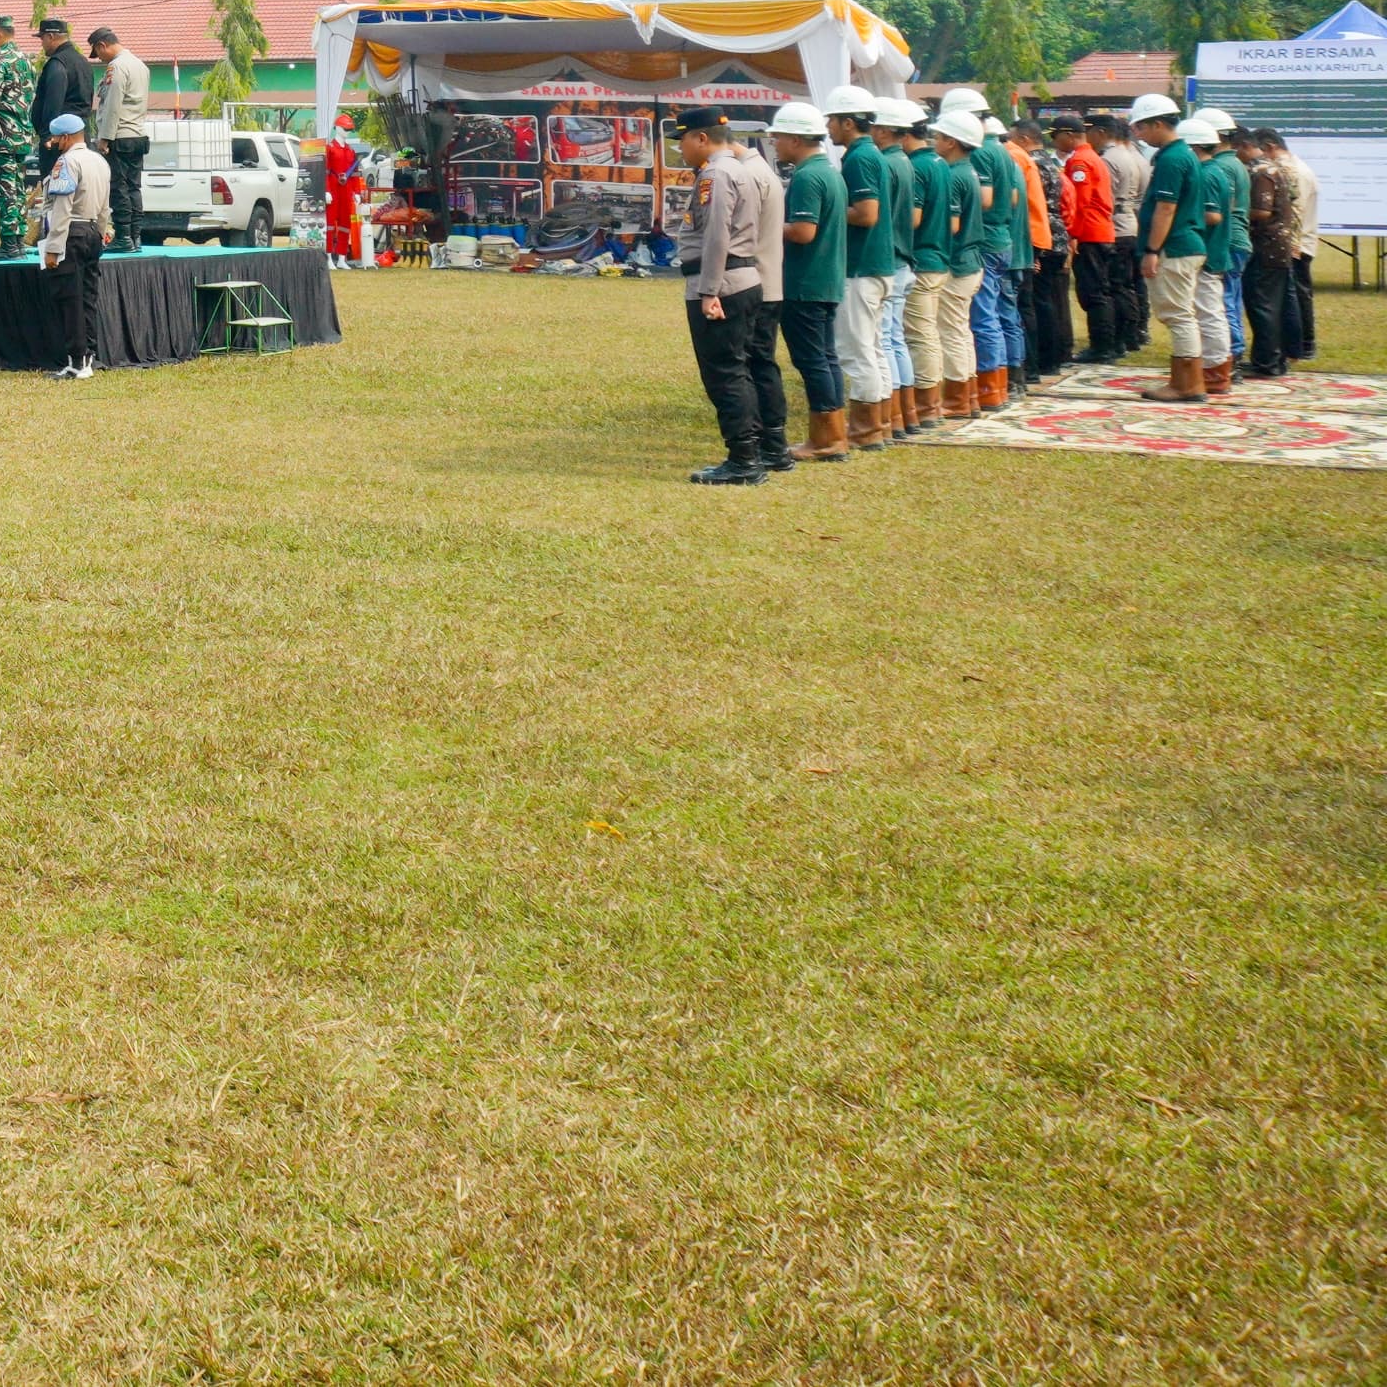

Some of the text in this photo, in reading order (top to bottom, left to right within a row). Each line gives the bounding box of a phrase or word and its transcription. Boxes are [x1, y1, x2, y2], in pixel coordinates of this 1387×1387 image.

[1238, 47, 1376, 59] IKRAR BERSAMA
[1227, 63, 1384, 73] PENCEGAHAN KARHUTLA
[522, 86, 588, 96] SARANA
[701, 84, 792, 101] KARHUTLA
